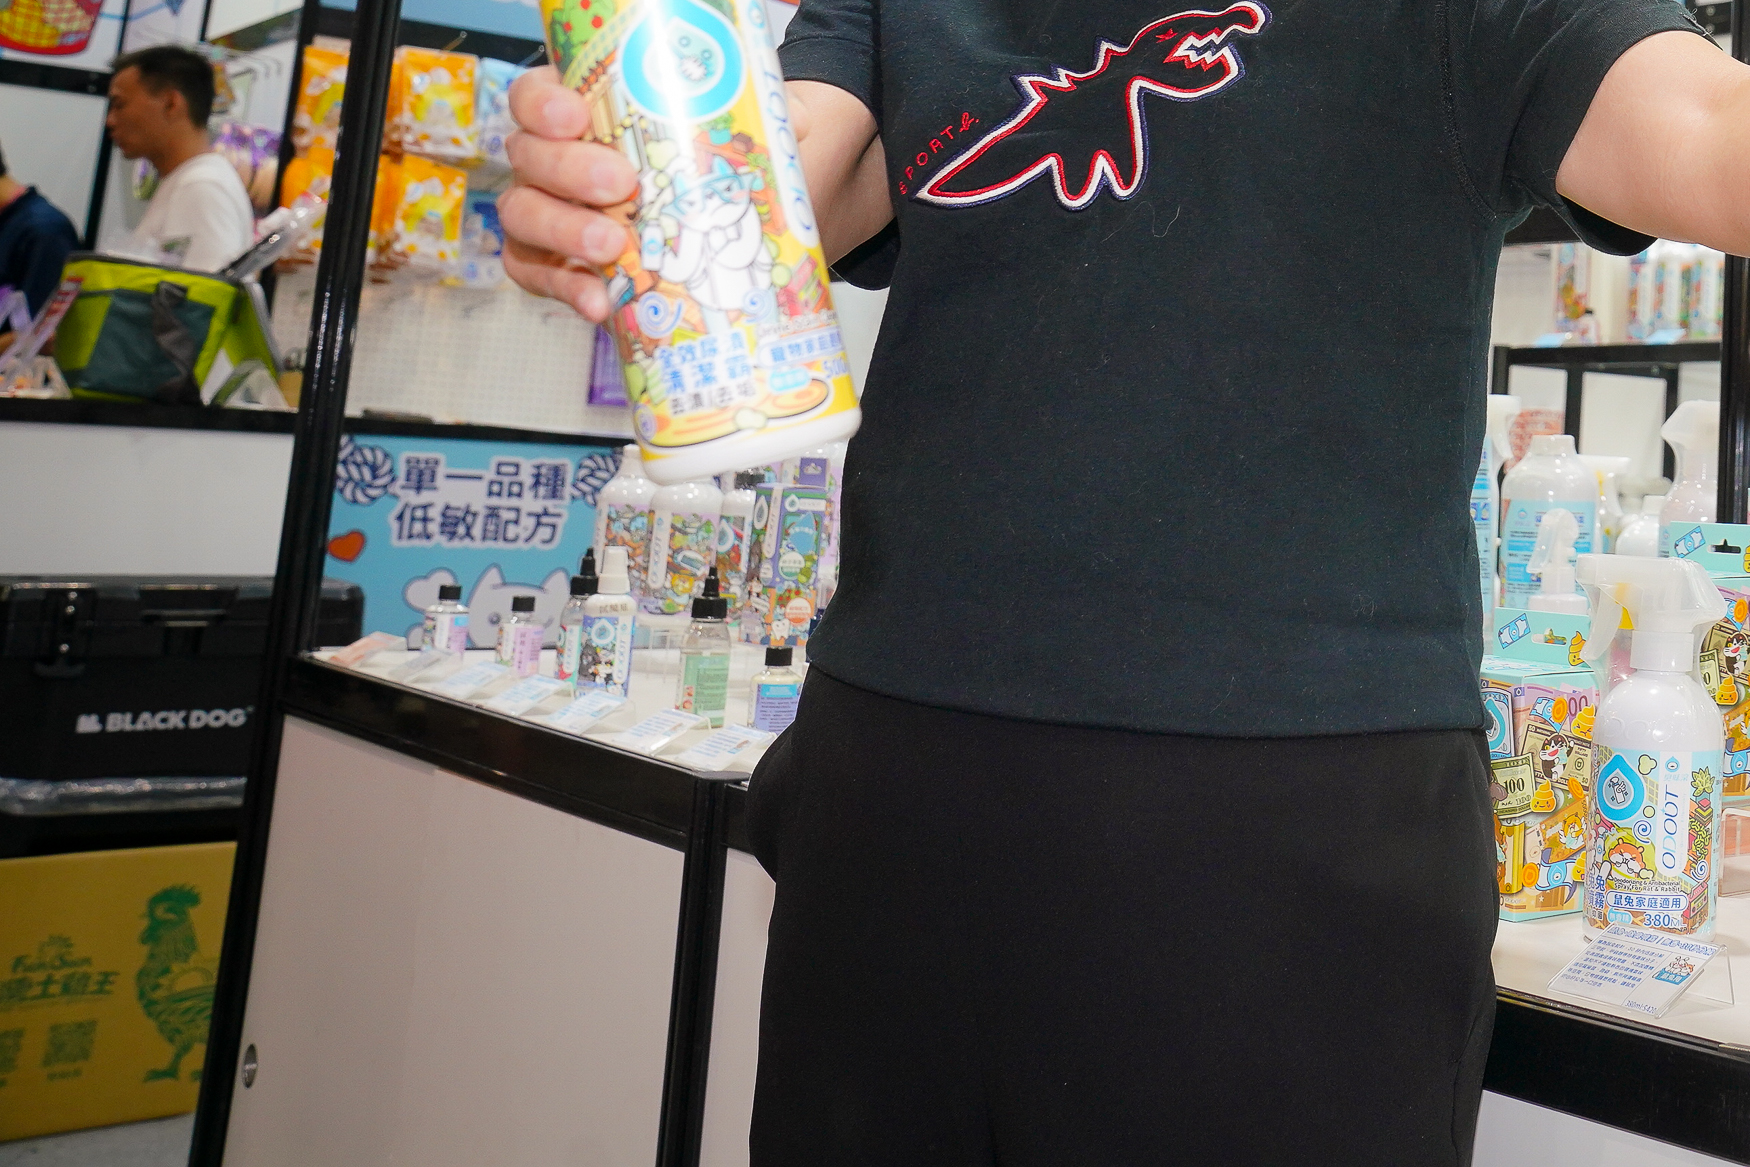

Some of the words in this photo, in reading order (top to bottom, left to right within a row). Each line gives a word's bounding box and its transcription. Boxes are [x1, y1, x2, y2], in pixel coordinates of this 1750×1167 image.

[400, 456, 568, 502] 單一品種
[394, 500, 563, 545] 低敏配方
[105, 710, 183, 731] BLACK
[189, 707, 246, 728] DOG
[1662, 784, 1680, 870] ODOUT
[1613, 894, 1682, 909] 鼠兔家庭適用
[1643, 913, 1688, 928] 380ML
